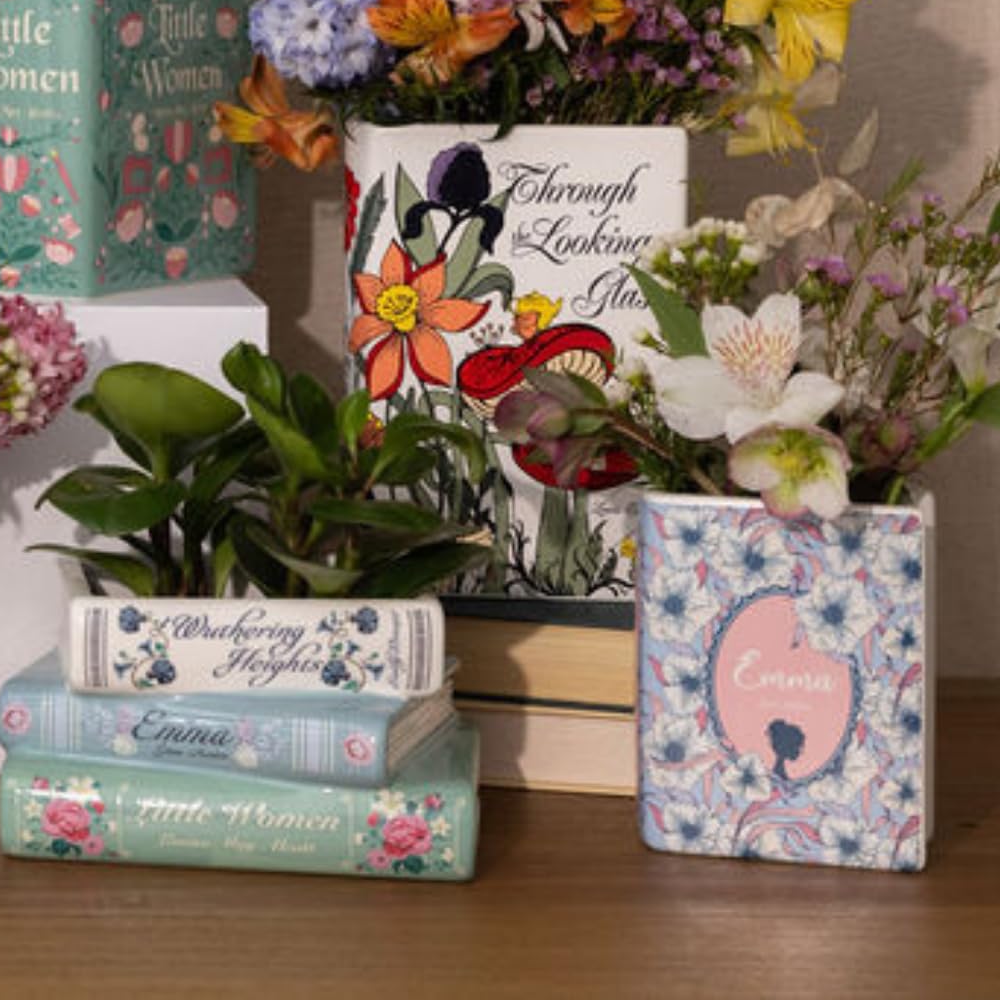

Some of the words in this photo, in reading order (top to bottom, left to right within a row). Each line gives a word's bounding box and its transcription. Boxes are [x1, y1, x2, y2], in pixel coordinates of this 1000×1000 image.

[149, 1, 208, 56] Little
[131, 56, 223, 98] Women
[497, 161, 651, 218] Through
[160, 606, 307, 656] Wuthering
[212, 641, 324, 688] Heights
[731, 648, 835, 694] Emma
[131, 708, 236, 747] Emma
[221, 801, 341, 831] Women
